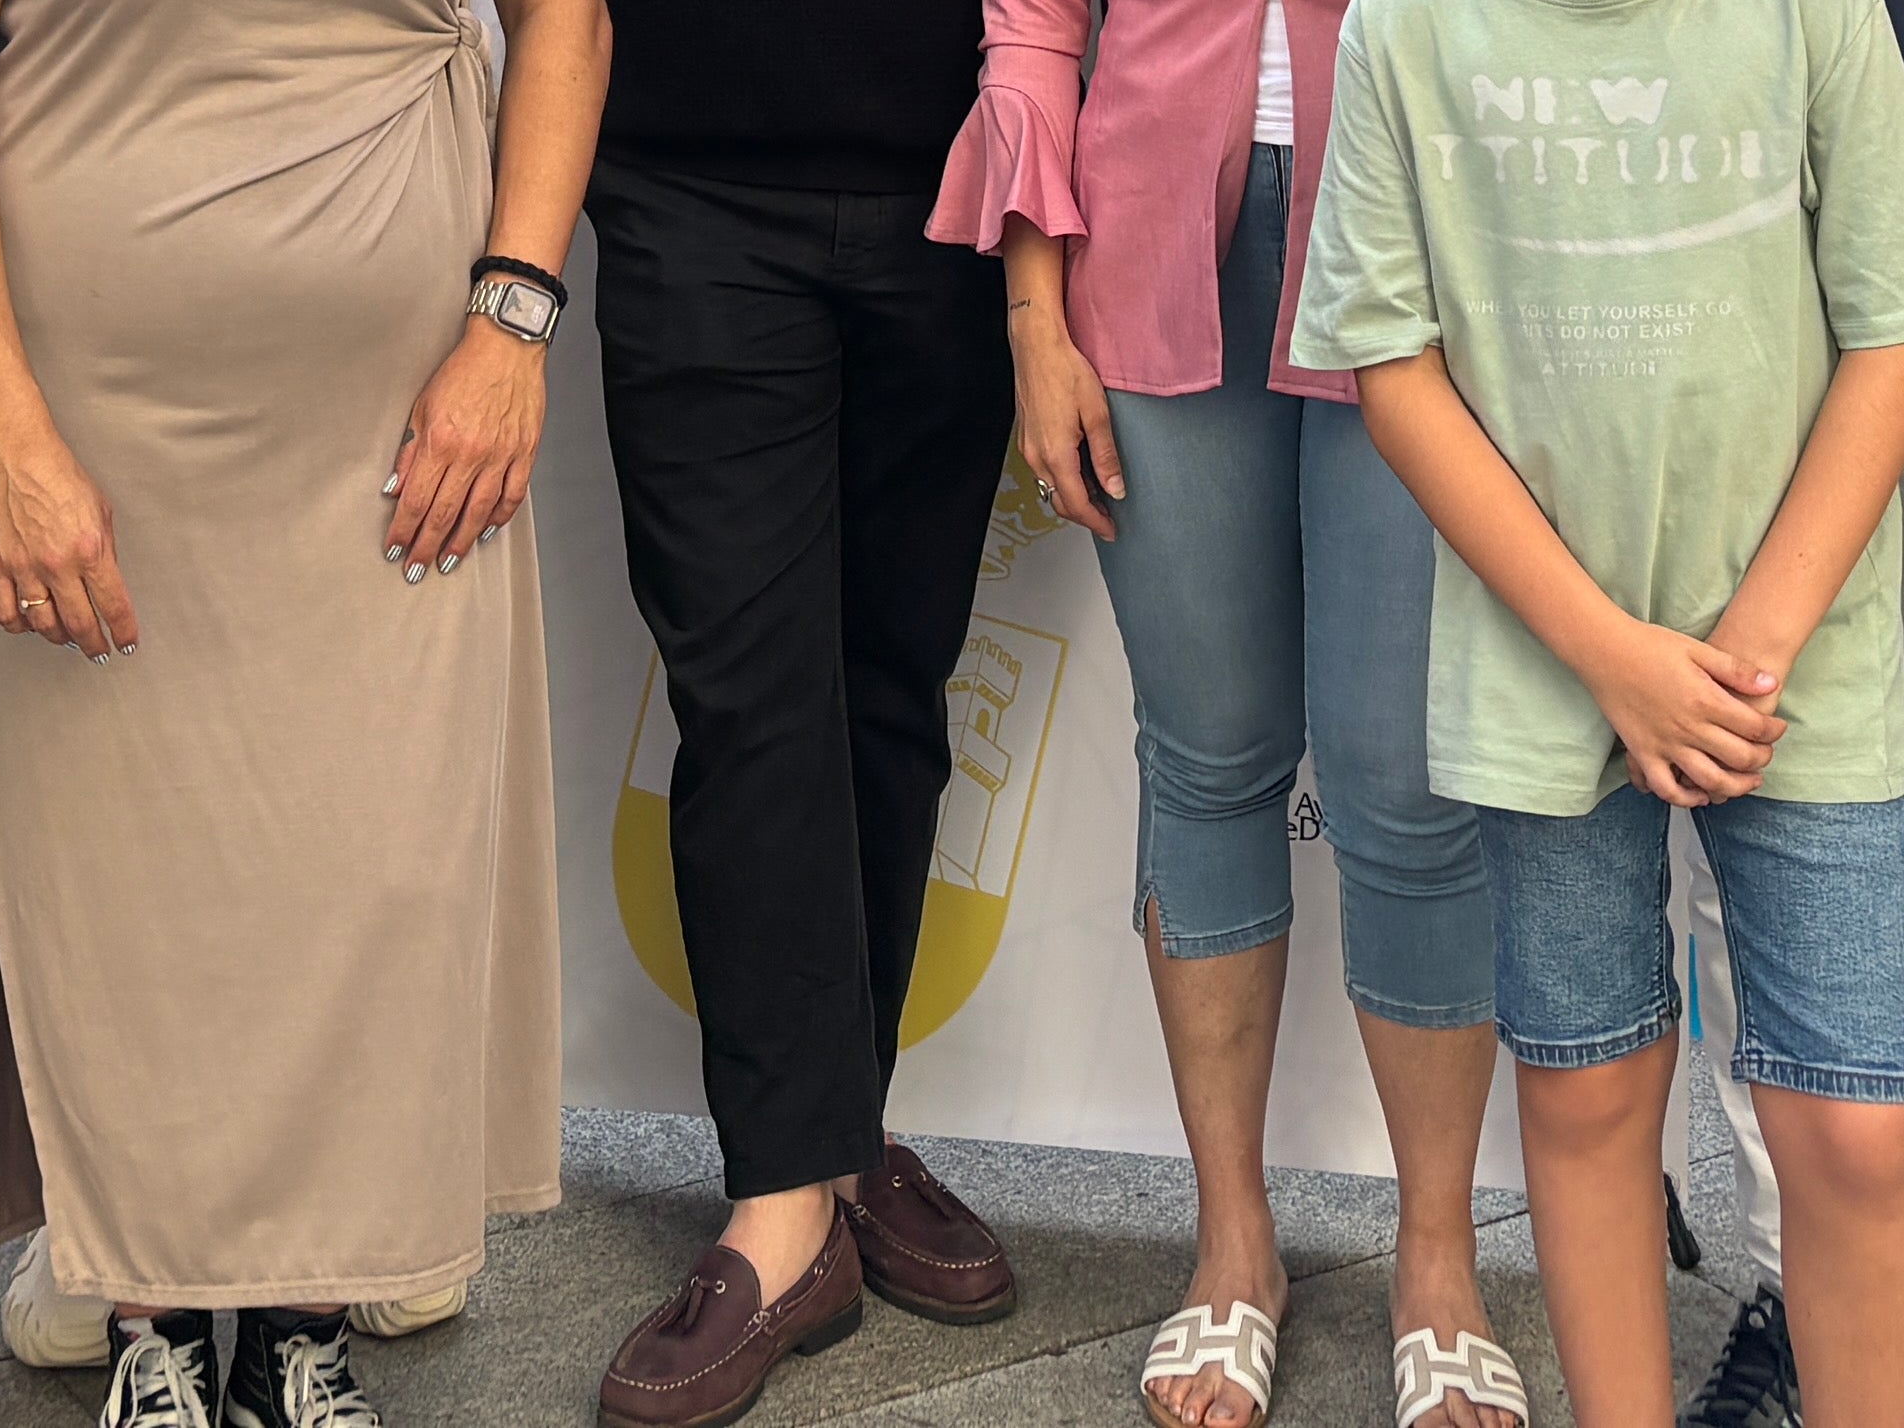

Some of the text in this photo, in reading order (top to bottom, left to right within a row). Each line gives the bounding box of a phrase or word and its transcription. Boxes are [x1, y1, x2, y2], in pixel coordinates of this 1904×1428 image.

[1556, 304, 1591, 321] LET
[1599, 302, 1698, 321] YOURSELF
[1560, 325, 1586, 340] DO
[1593, 324, 1632, 340] NOT
[1638, 322, 1696, 339] EXIST
